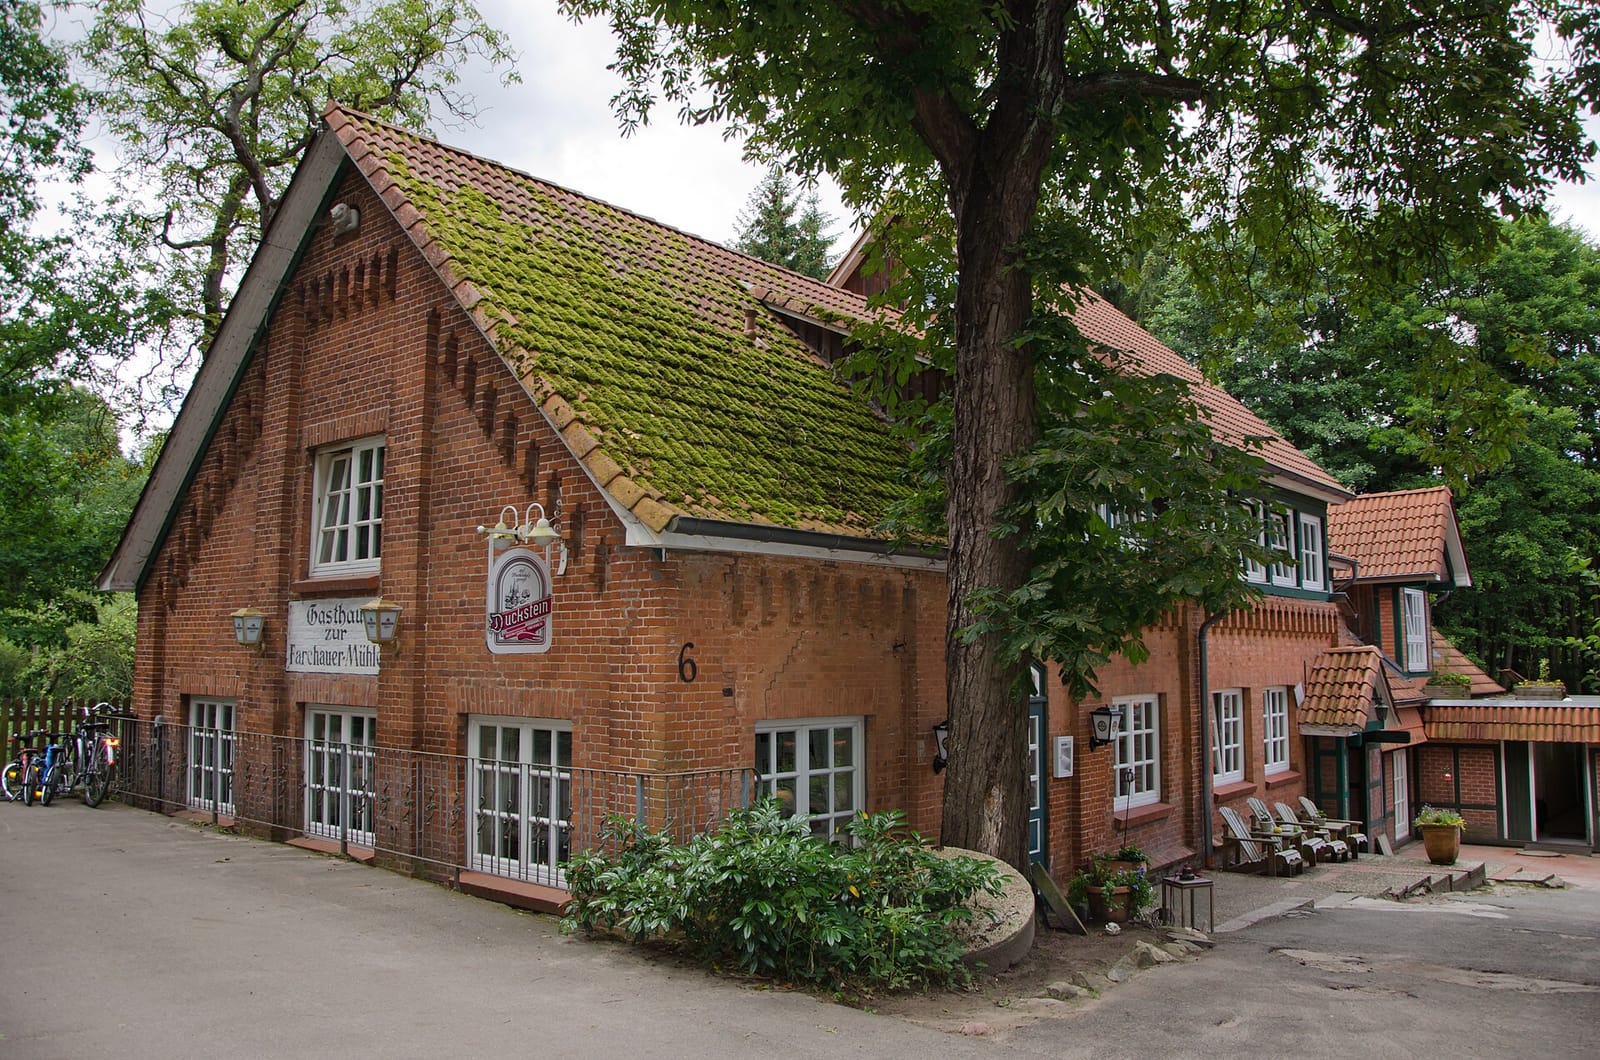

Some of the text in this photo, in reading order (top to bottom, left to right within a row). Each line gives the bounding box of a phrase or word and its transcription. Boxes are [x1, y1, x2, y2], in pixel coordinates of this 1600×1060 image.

[306, 603, 363, 626] Gasthau
[490, 601, 549, 633] Duckstein
[324, 628, 348, 641] zur
[678, 642, 697, 683] 6
